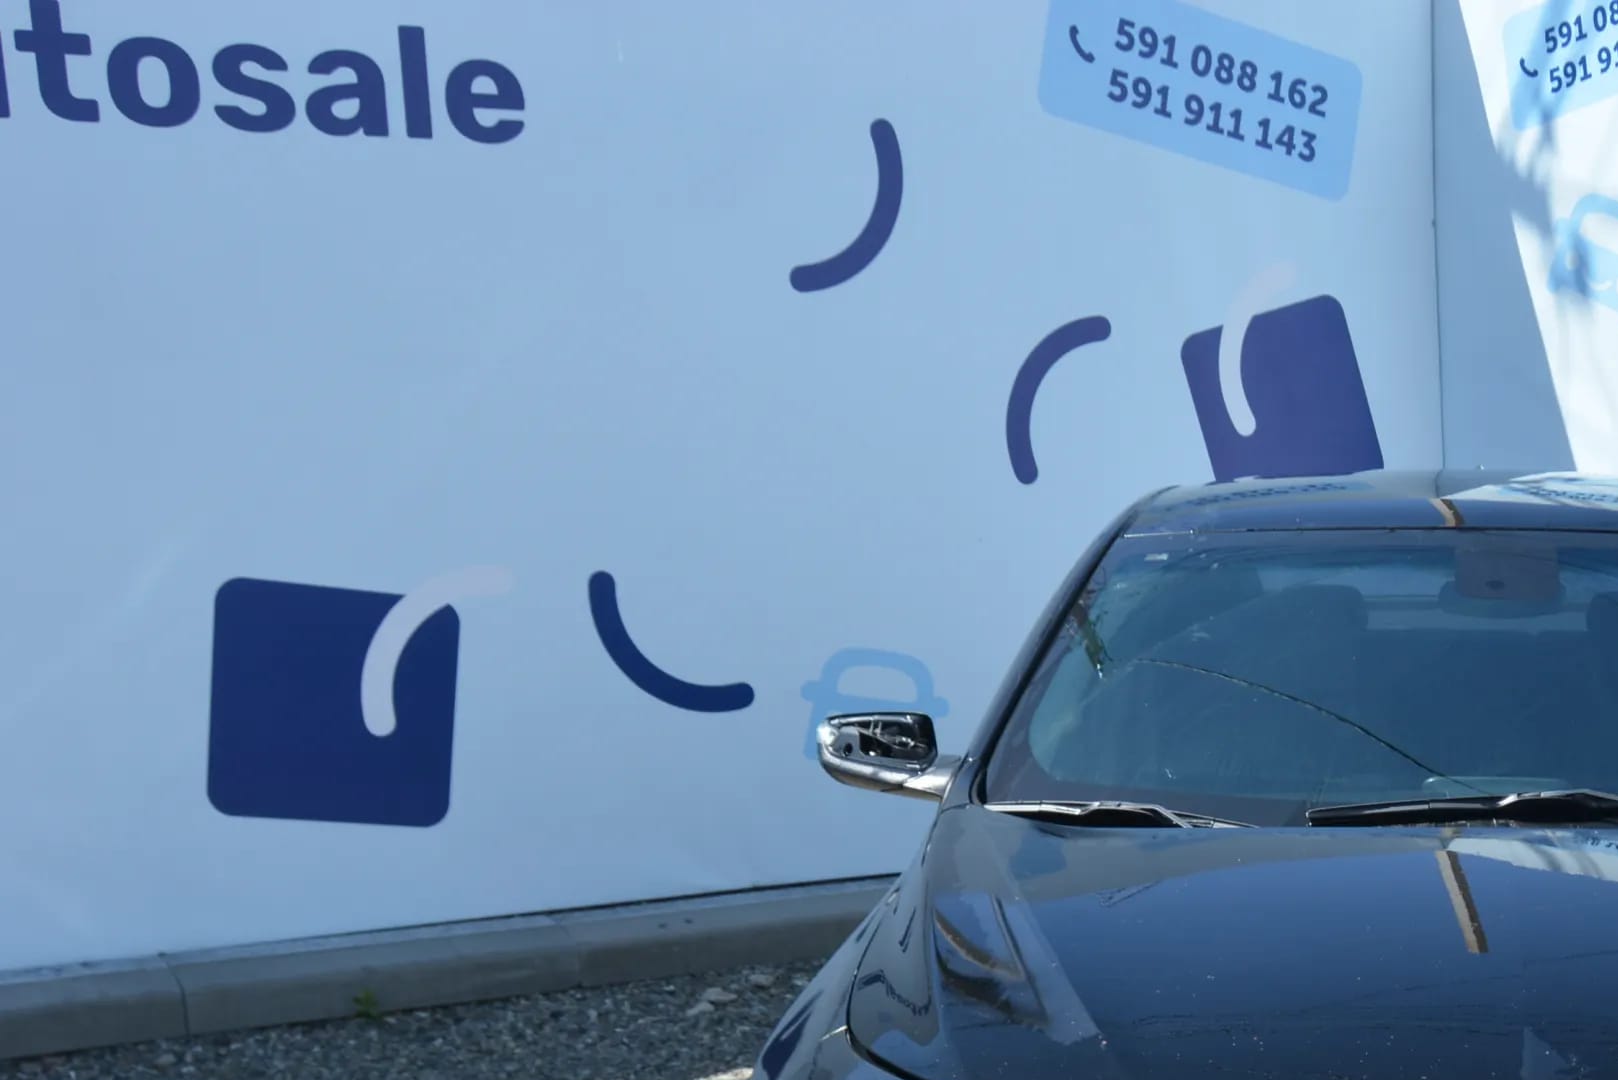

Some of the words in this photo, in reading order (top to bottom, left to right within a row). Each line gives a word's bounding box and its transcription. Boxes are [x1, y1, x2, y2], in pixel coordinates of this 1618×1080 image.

[0, 0, 526, 145] tosale
[1114, 17, 1179, 69] 591
[1190, 44, 1258, 93] 088
[1267, 71, 1329, 118] 162
[1544, 15, 1588, 54] 591
[1549, 55, 1592, 93] 591
[1107, 68, 1172, 119] 591
[1183, 93, 1245, 142] 911
[1255, 118, 1317, 163] 143
